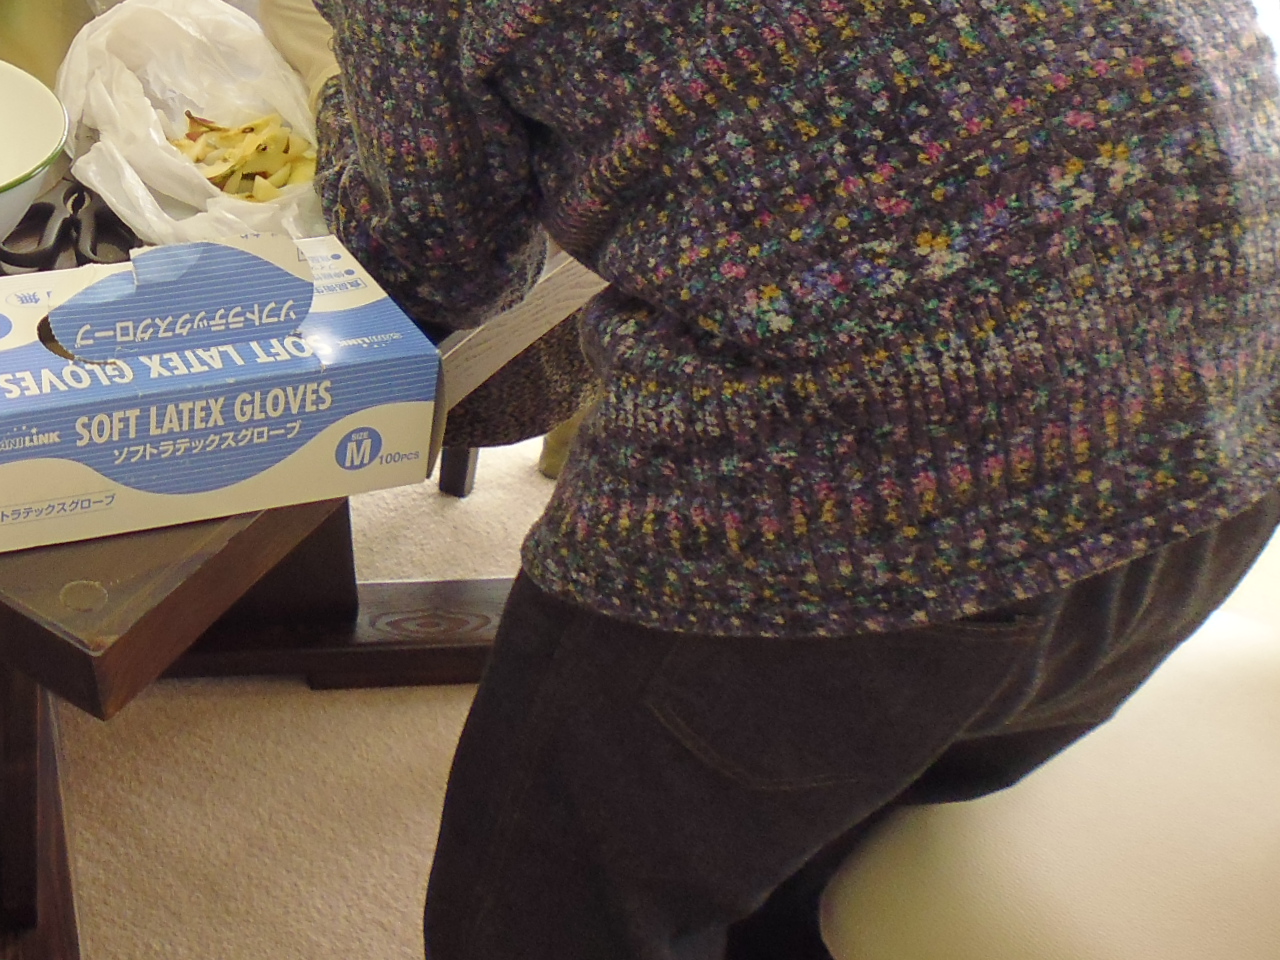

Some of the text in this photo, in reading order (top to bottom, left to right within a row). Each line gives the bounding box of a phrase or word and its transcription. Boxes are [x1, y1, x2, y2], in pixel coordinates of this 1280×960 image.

[74, 299, 297, 349] ソフトラテックスグローブ
[138, 343, 246, 379] LATEX
[248, 334, 333, 364] SOFT
[75, 380, 332, 447] SOFT LATEX GLOVES
[114, 420, 303, 464] ソフトラテックスグローブ
[352, 431, 369, 440] SIZE
[344, 438, 372, 467] M
[379, 451, 420, 465] 100PCS
